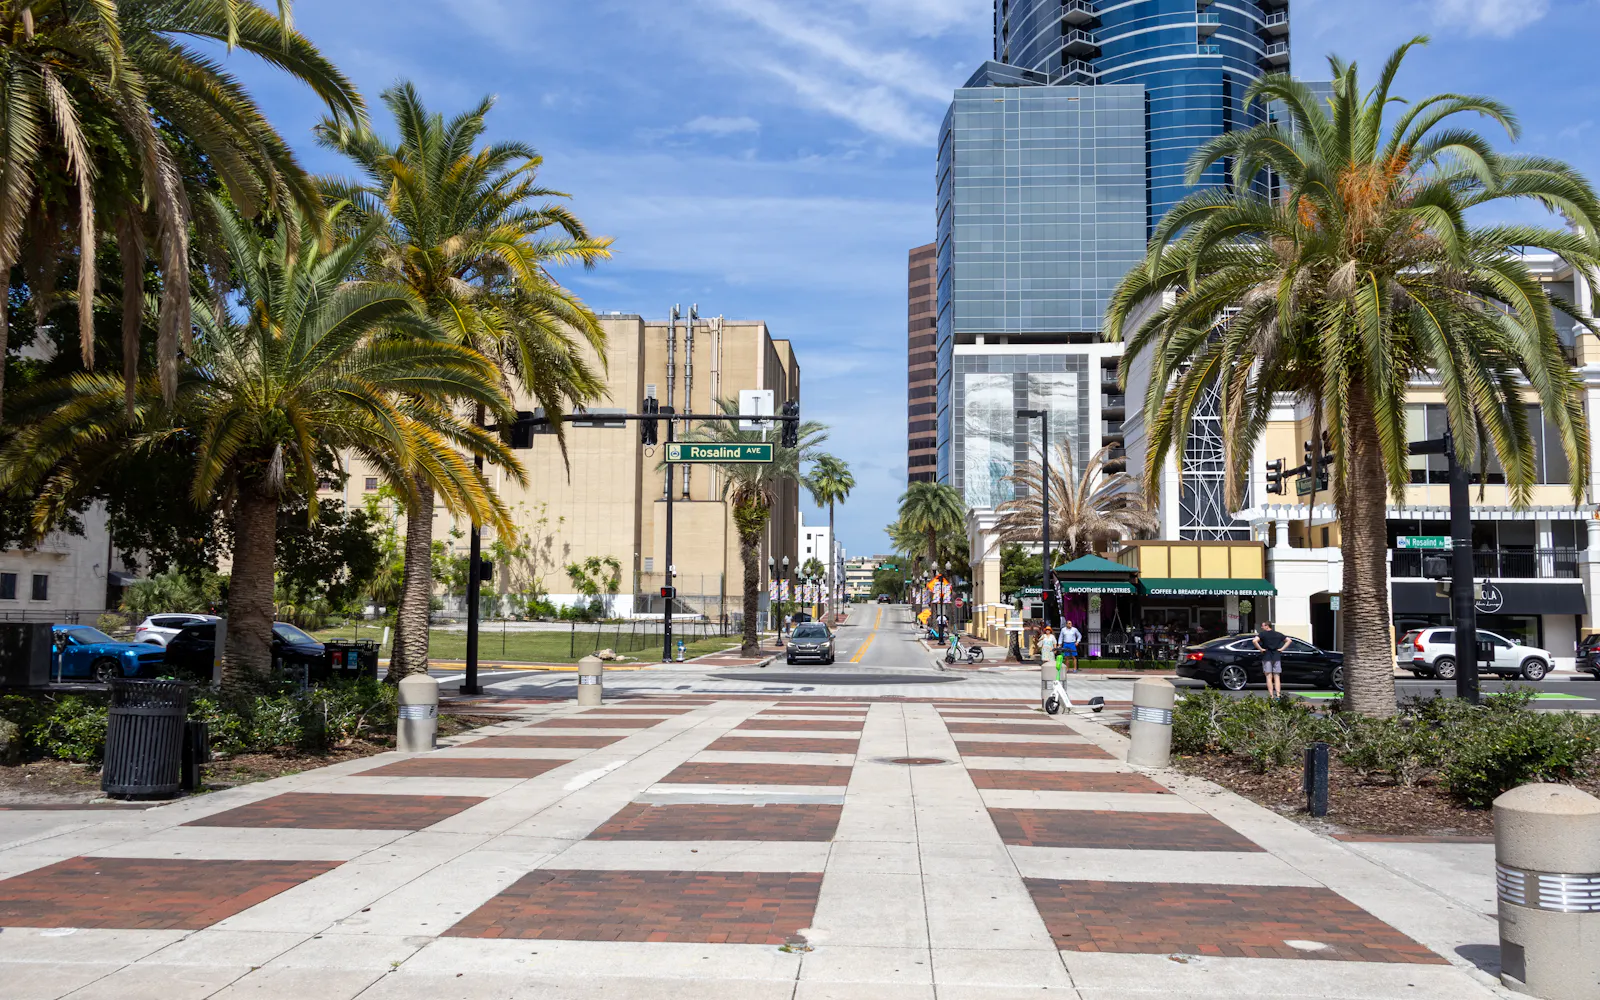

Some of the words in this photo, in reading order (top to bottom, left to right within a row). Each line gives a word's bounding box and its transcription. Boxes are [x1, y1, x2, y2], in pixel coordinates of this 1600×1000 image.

[691, 447, 741, 458] Rosalind
[1406, 538, 1411, 546] N
[1412, 538, 1437, 546] Rosalind
[1480, 590, 1497, 600] OLA
